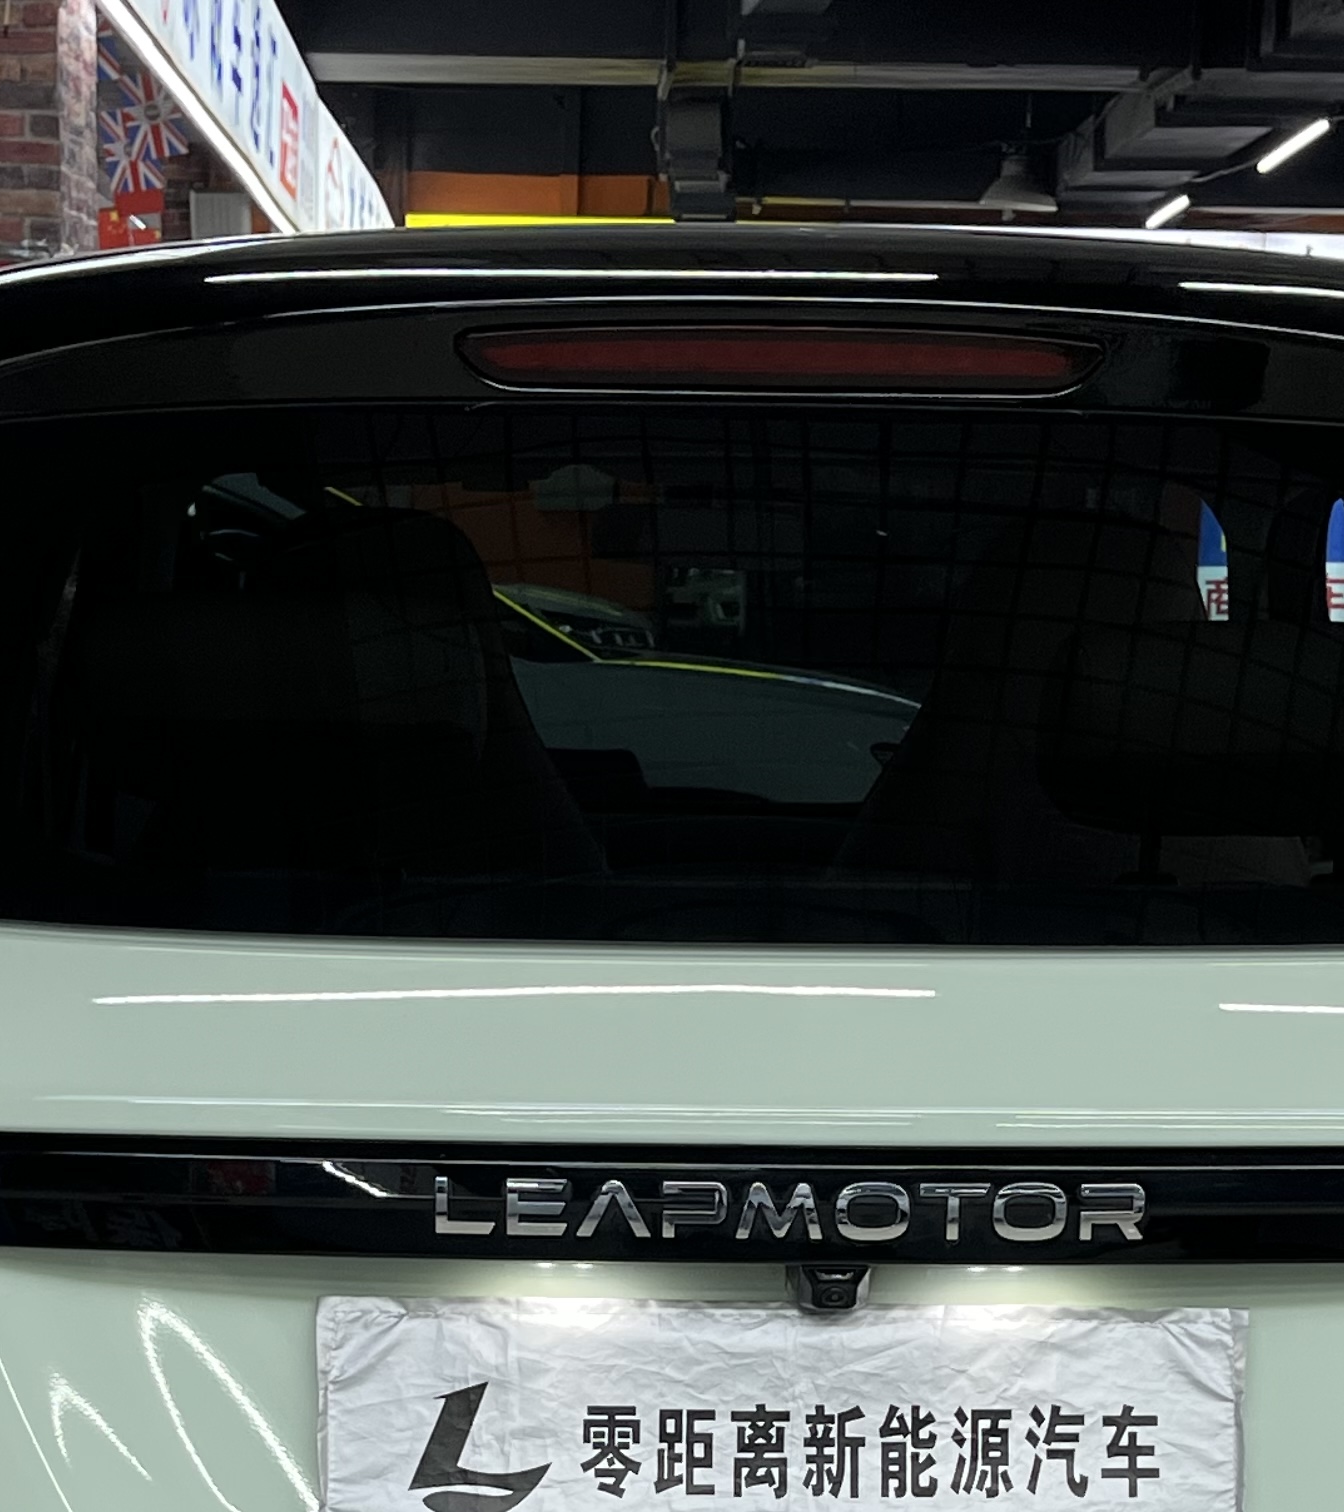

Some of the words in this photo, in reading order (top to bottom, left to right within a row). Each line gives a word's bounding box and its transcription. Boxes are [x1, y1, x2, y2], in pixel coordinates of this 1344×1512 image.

[435, 1176, 1145, 1242] LEAPMOTOR
[579, 1403, 1162, 1499] 零距离新能源汽车
